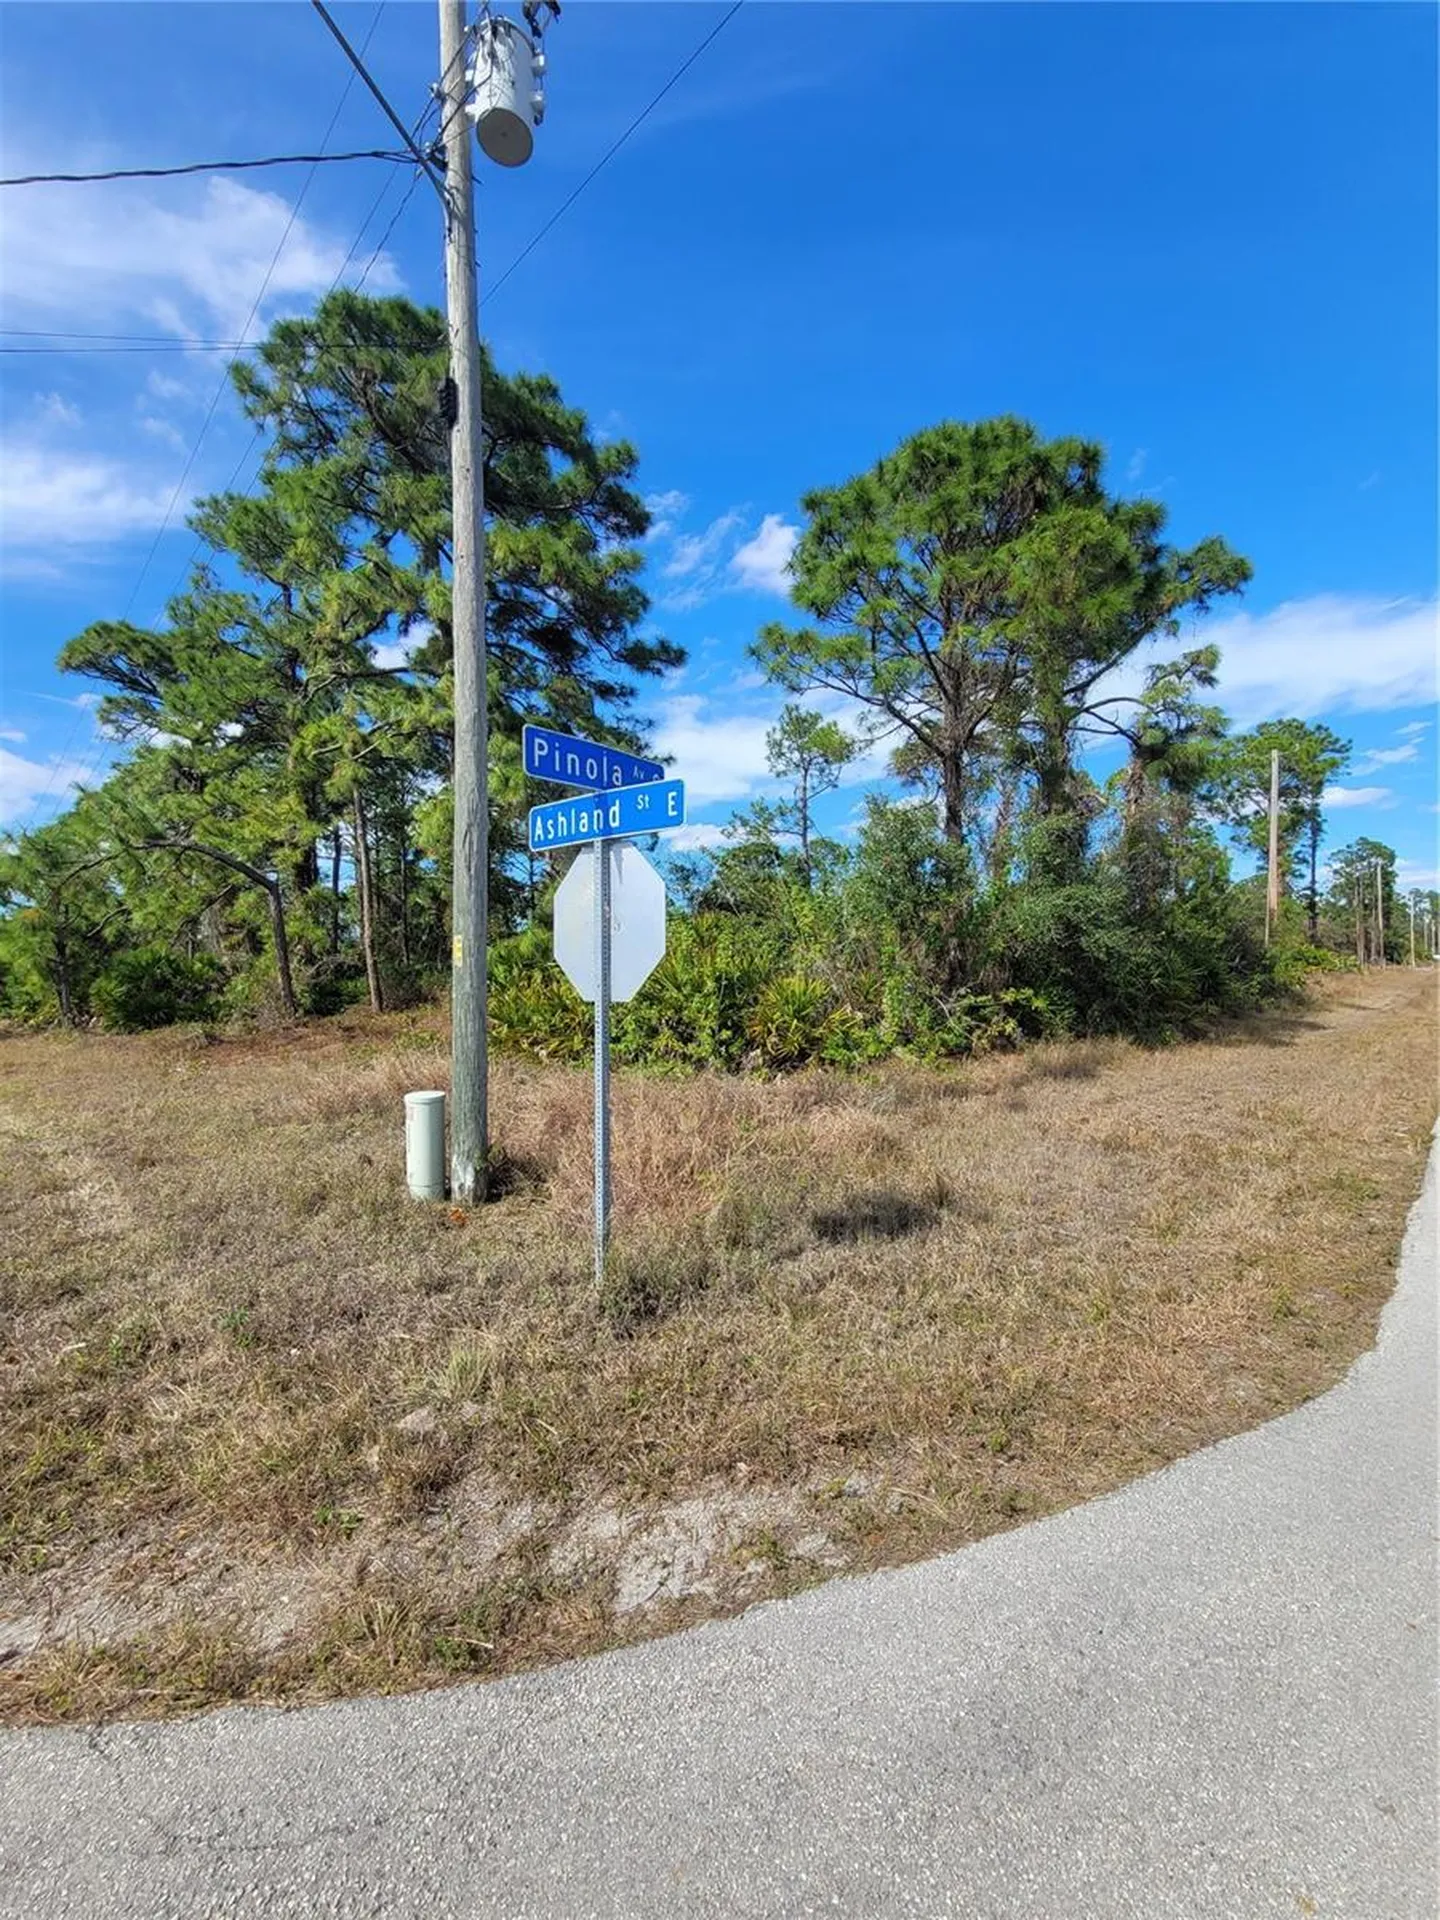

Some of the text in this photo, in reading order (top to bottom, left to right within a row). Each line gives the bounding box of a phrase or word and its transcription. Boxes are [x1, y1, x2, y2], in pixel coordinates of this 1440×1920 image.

[534, 737, 622, 786] Pinola
[534, 791, 678, 842] Ashland St E
